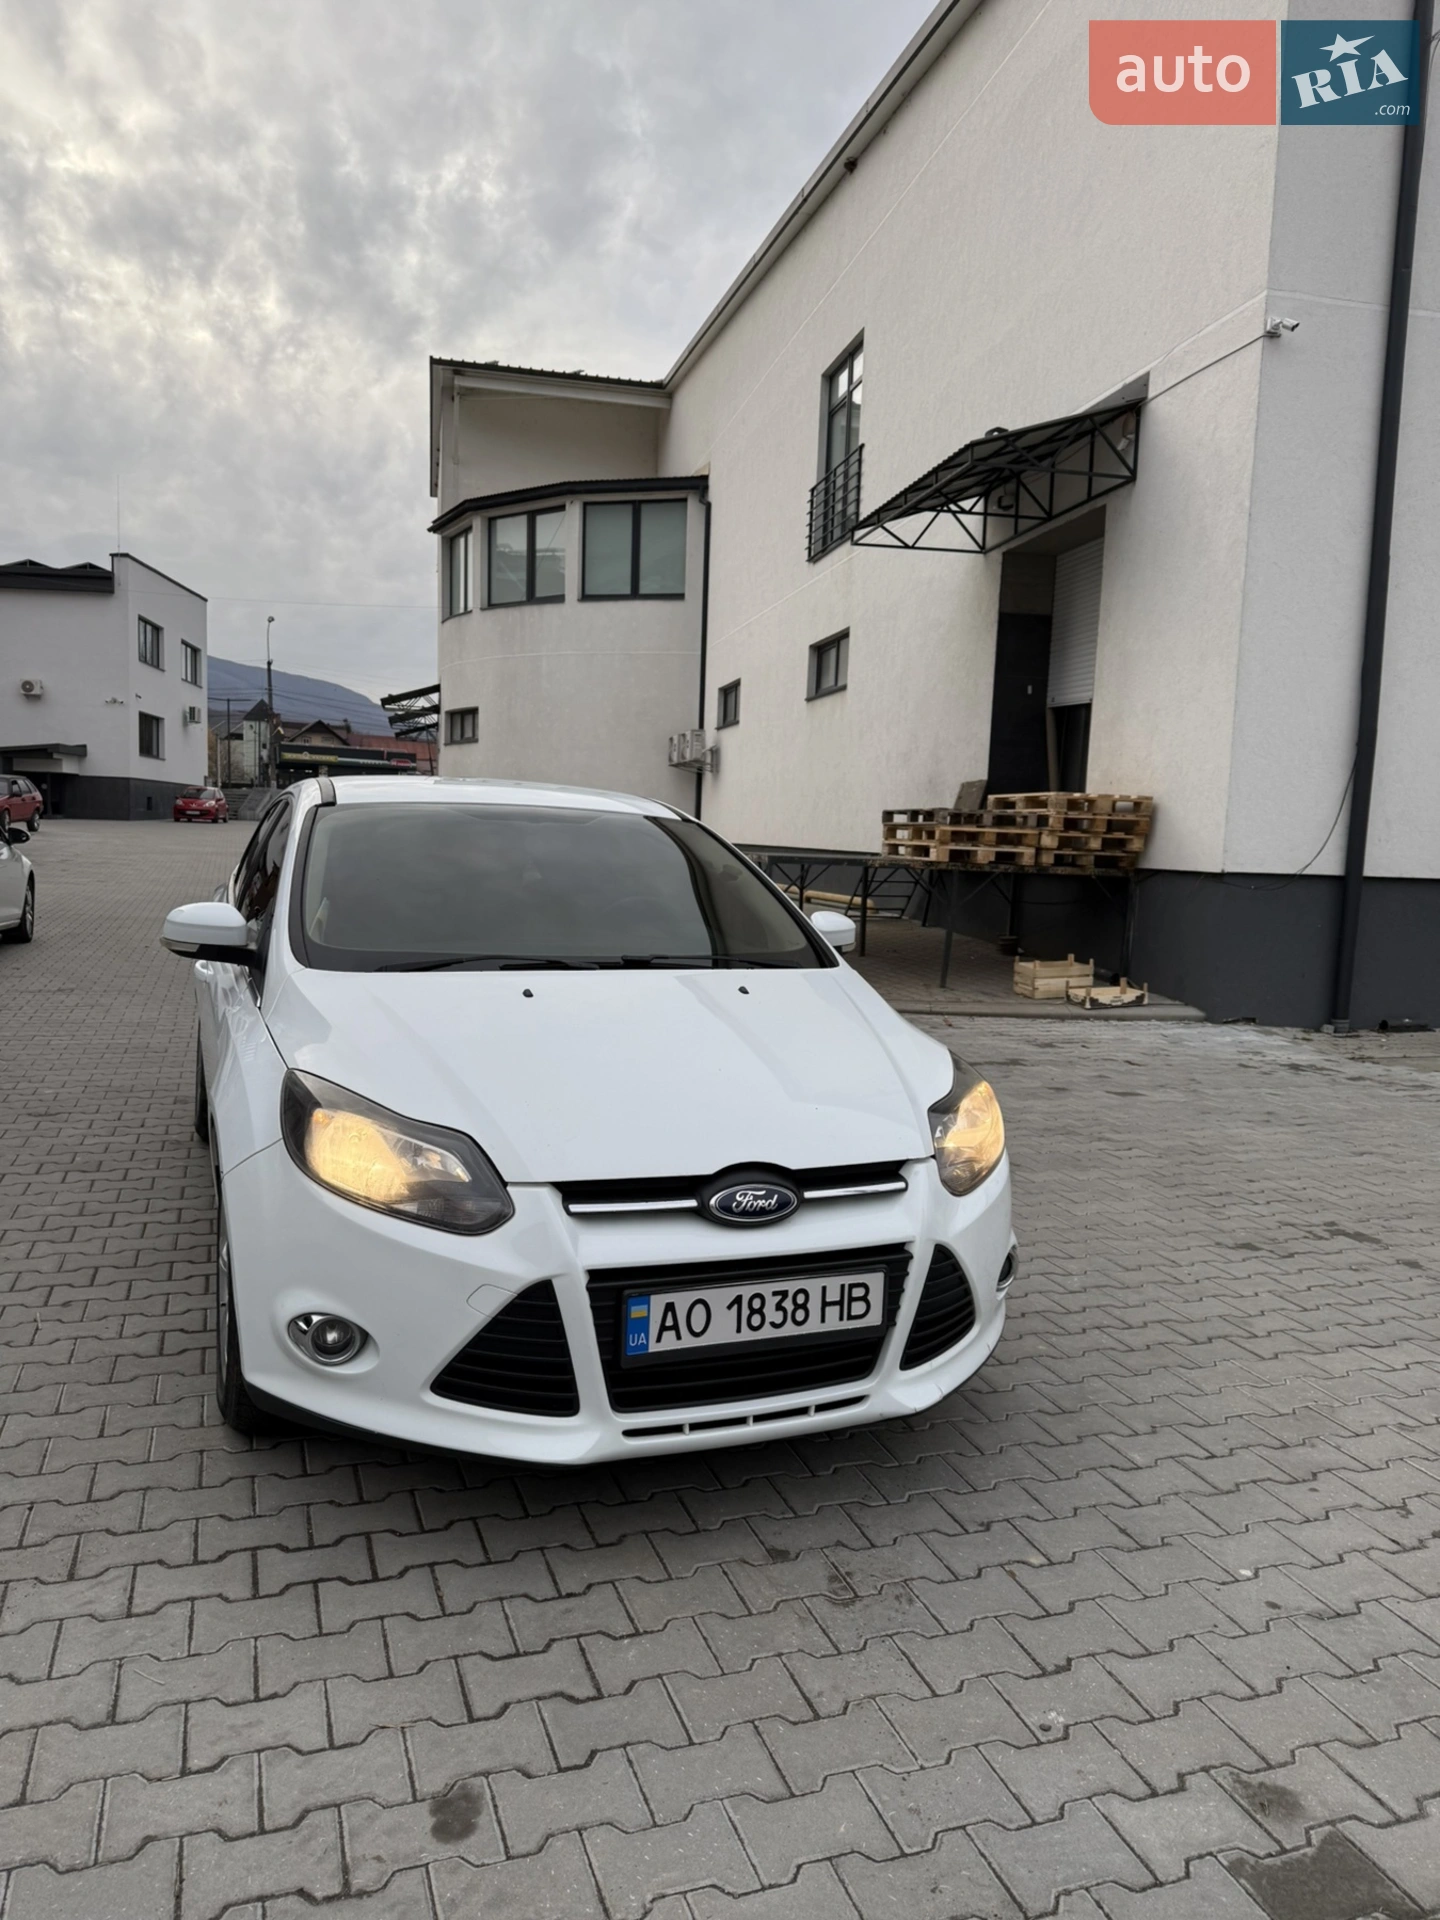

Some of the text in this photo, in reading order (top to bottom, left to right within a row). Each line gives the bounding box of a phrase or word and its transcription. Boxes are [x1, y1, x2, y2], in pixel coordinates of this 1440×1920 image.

[732, 1189, 779, 1214] Ford
[655, 1281, 871, 1343] AO 1838 HB
[629, 1332, 648, 1347] UA
